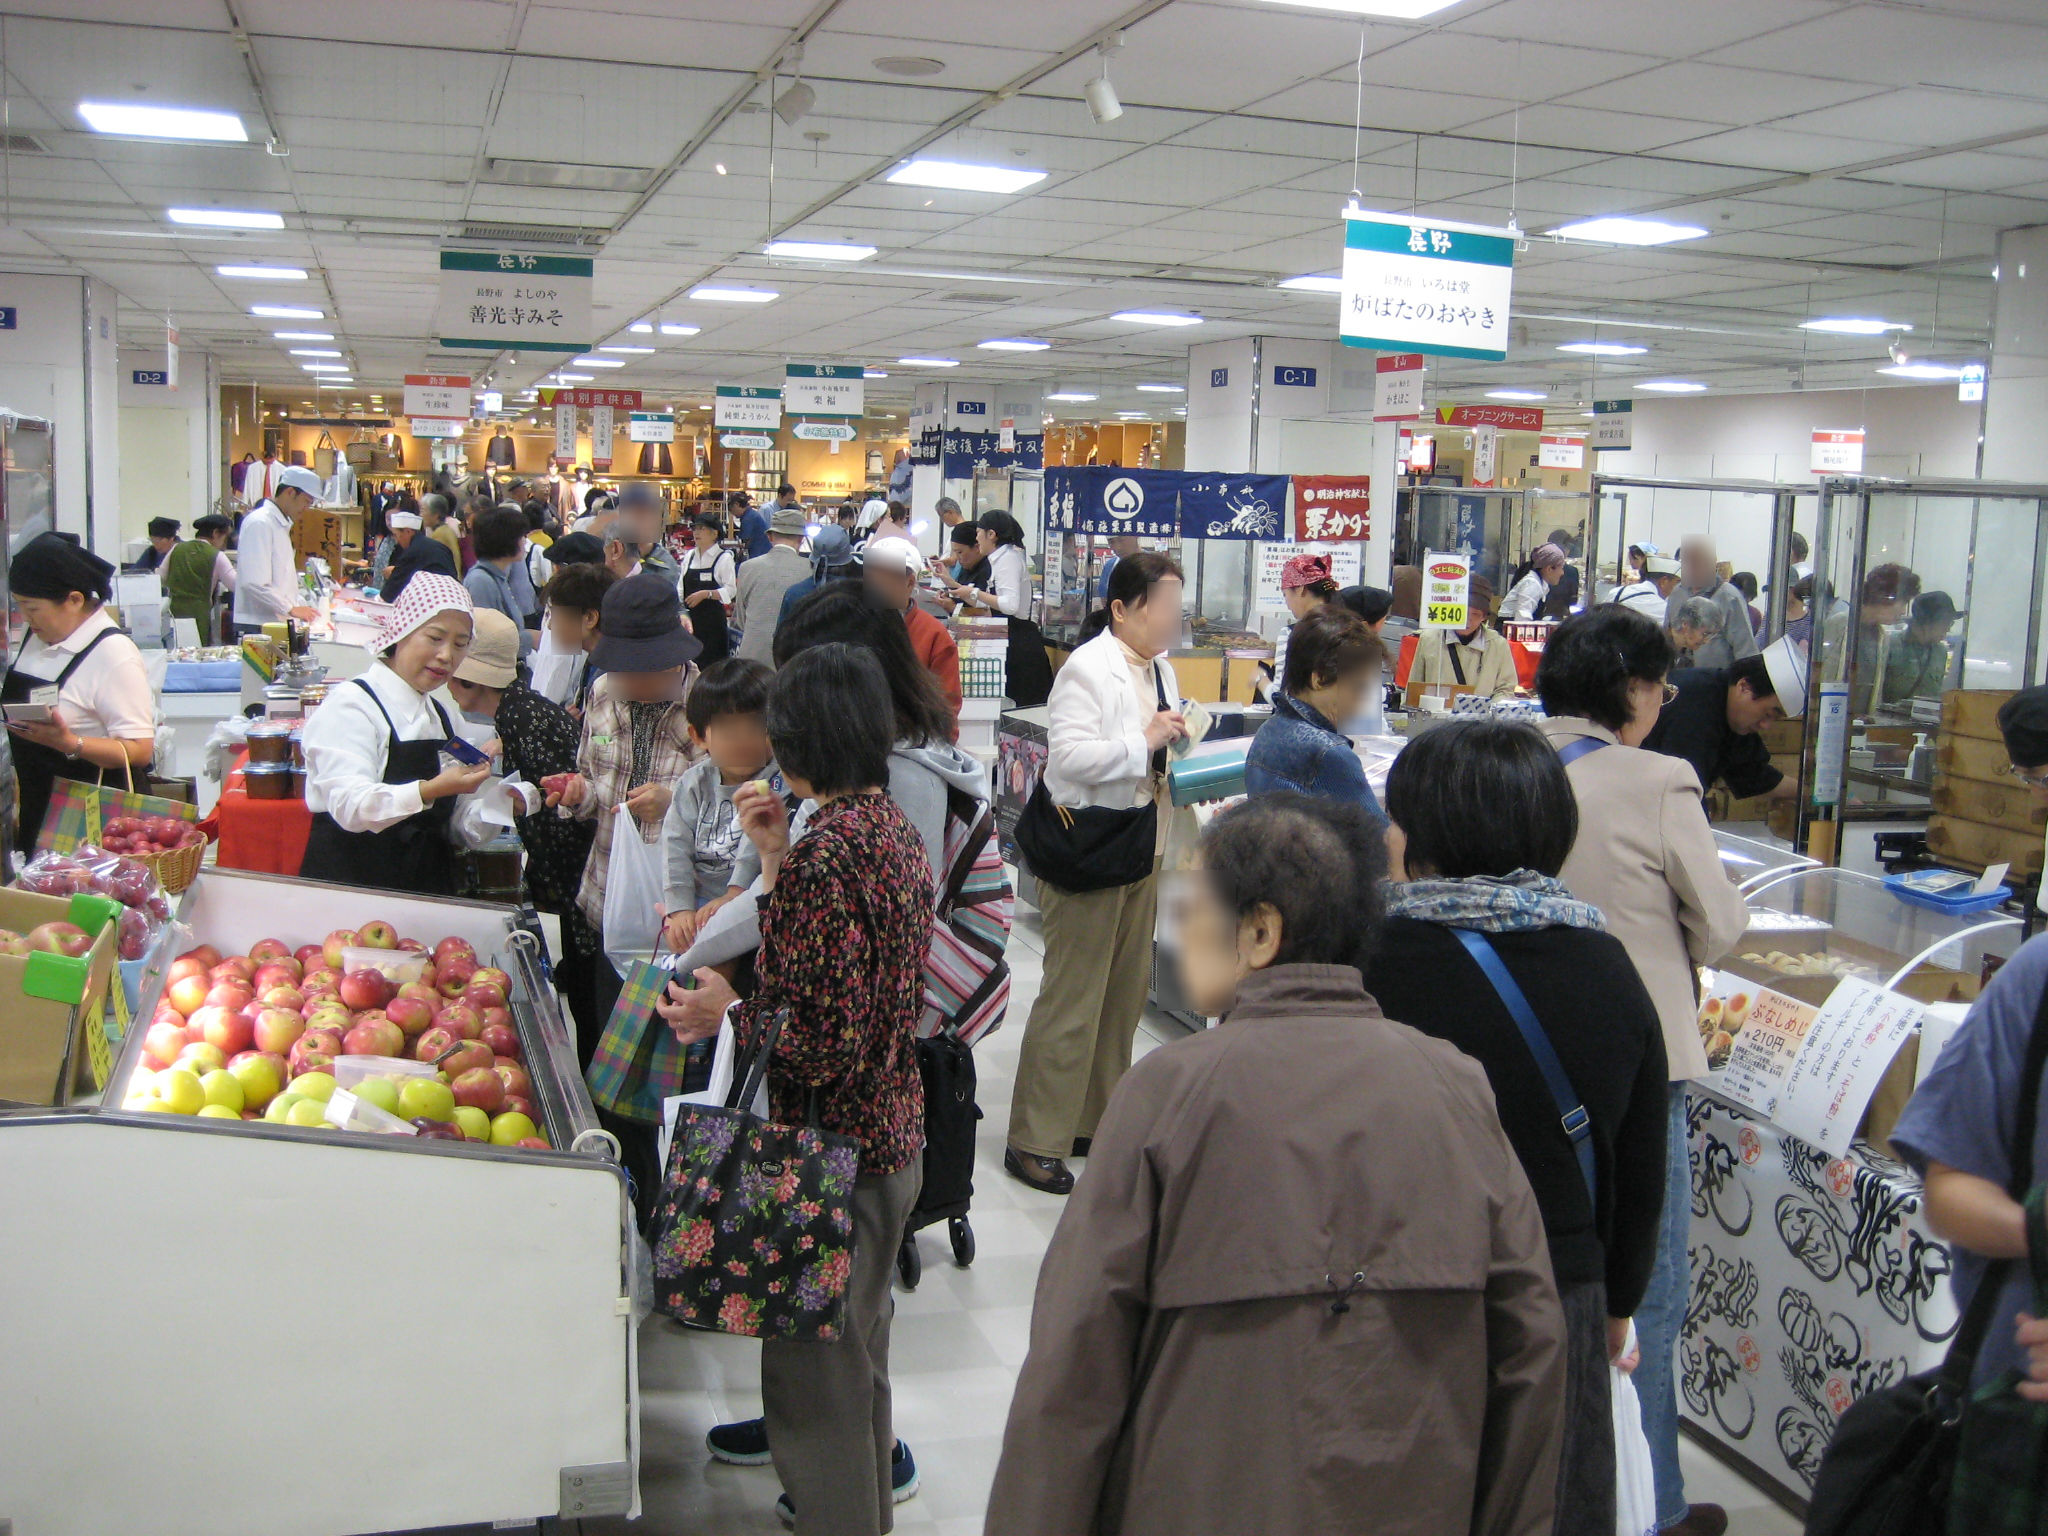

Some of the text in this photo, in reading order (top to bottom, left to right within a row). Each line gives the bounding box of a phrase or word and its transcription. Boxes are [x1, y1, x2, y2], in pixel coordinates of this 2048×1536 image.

[1407, 226, 1452, 254] 長野
[497, 255, 538, 269] 長野
[1422, 277, 1471, 294] いろは堂
[476, 288, 558, 300] 長野市 よしのや
[470, 305, 563, 326] 善光寺みそ
[1352, 293, 1495, 329] 炉ばたのおやき
[139, 373, 161, 384] D-2
[815, 366, 836, 376] 長野
[1214, 371, 1225, 385] C-1
[1283, 369, 1308, 384] C-1
[563, 392, 634, 406] 特別提供品
[739, 388, 757, 397] 長野
[962, 404, 980, 413] D-1
[1461, 409, 1537, 425] オープニングサービス
[1317, 488, 1369, 500] 明治神宮献上
[1428, 606, 1462, 622] ¥540
[1752, 1003, 1809, 1037] ぶなしめじ
[1810, 988, 1870, 1076] アレルギーの方は
[1752, 1029, 1785, 1053] 210円
